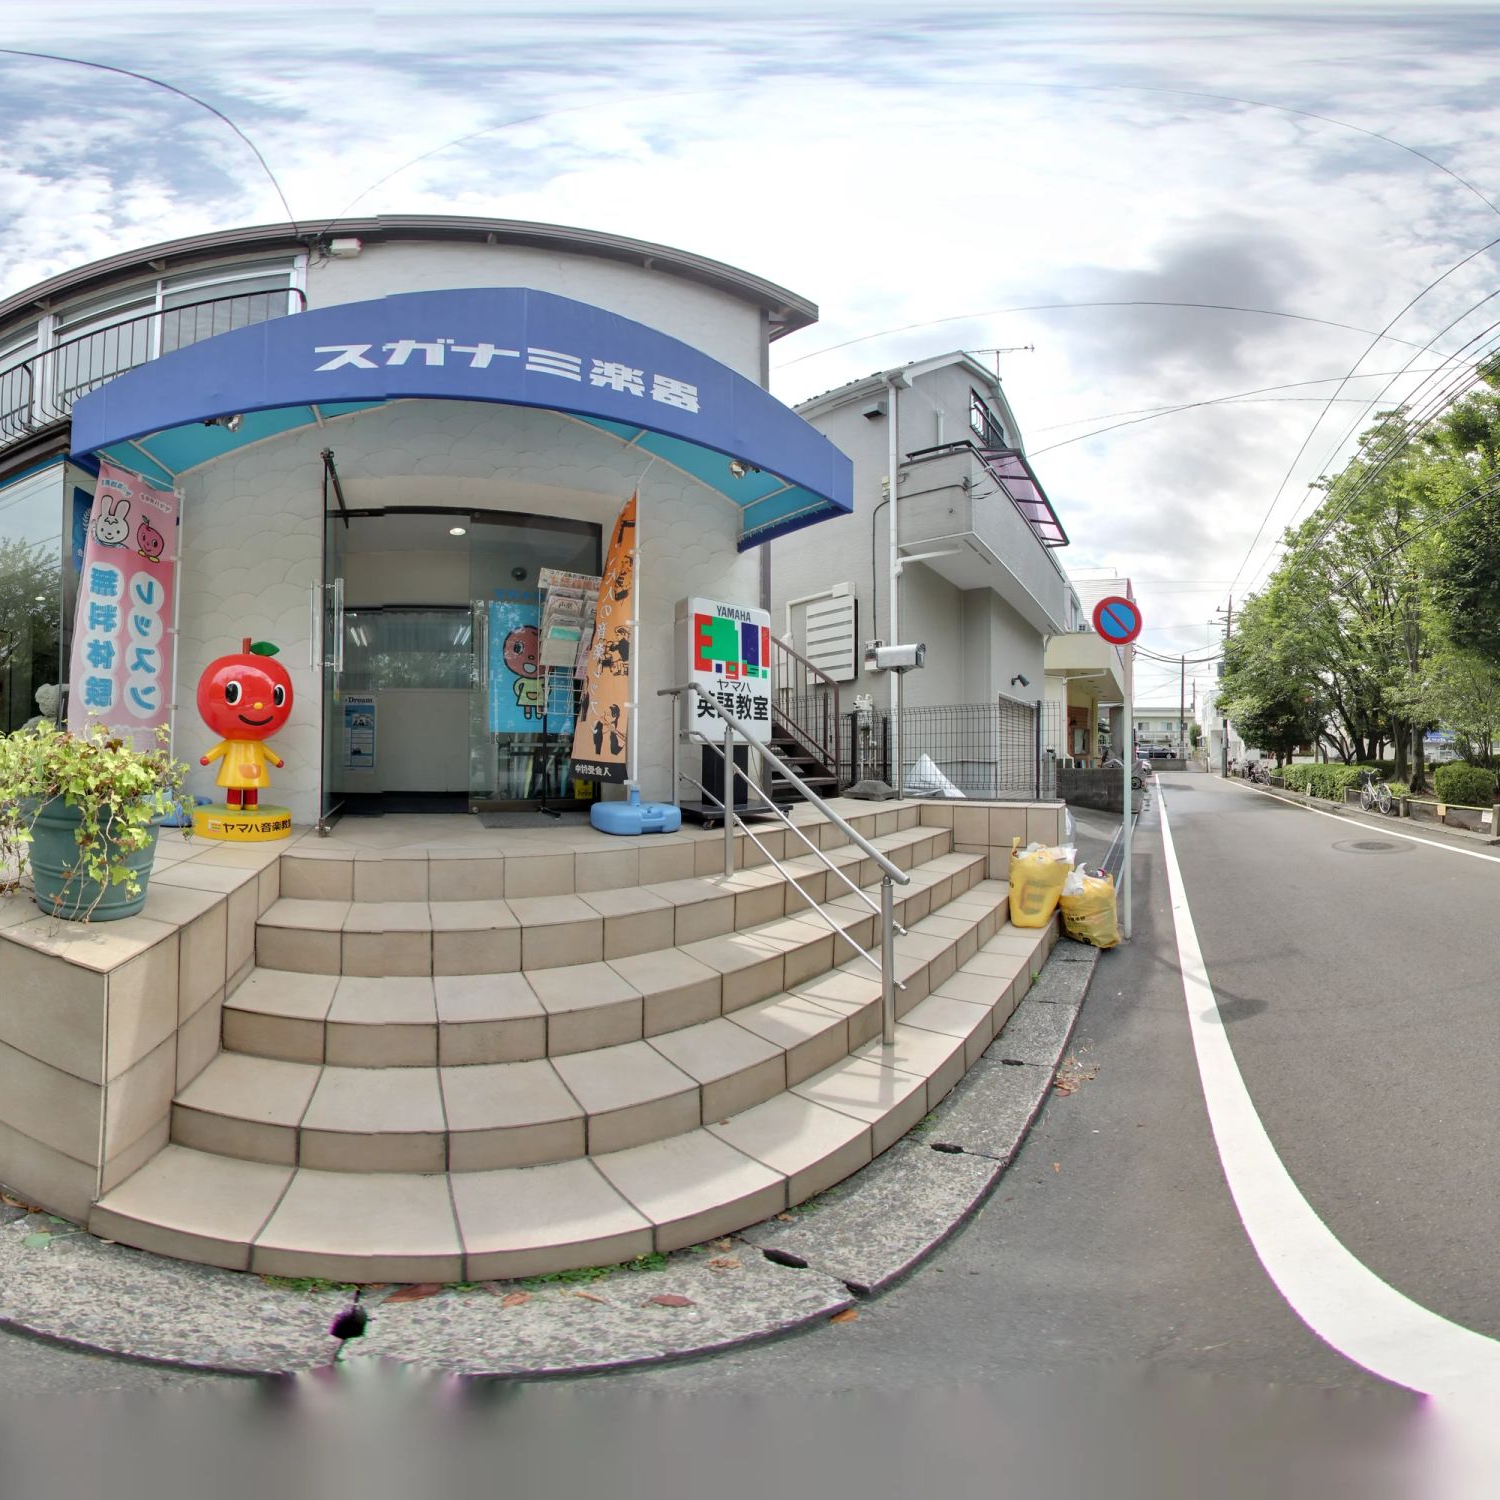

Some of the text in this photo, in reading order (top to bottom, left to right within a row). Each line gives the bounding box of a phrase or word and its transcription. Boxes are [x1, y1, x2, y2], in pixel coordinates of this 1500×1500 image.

[313, 338, 701, 414] スガナミ楽器
[716, 605, 751, 622] YAMAHA
[717, 679, 751, 693] ヤマハ
[697, 690, 769, 721] 英語教室
